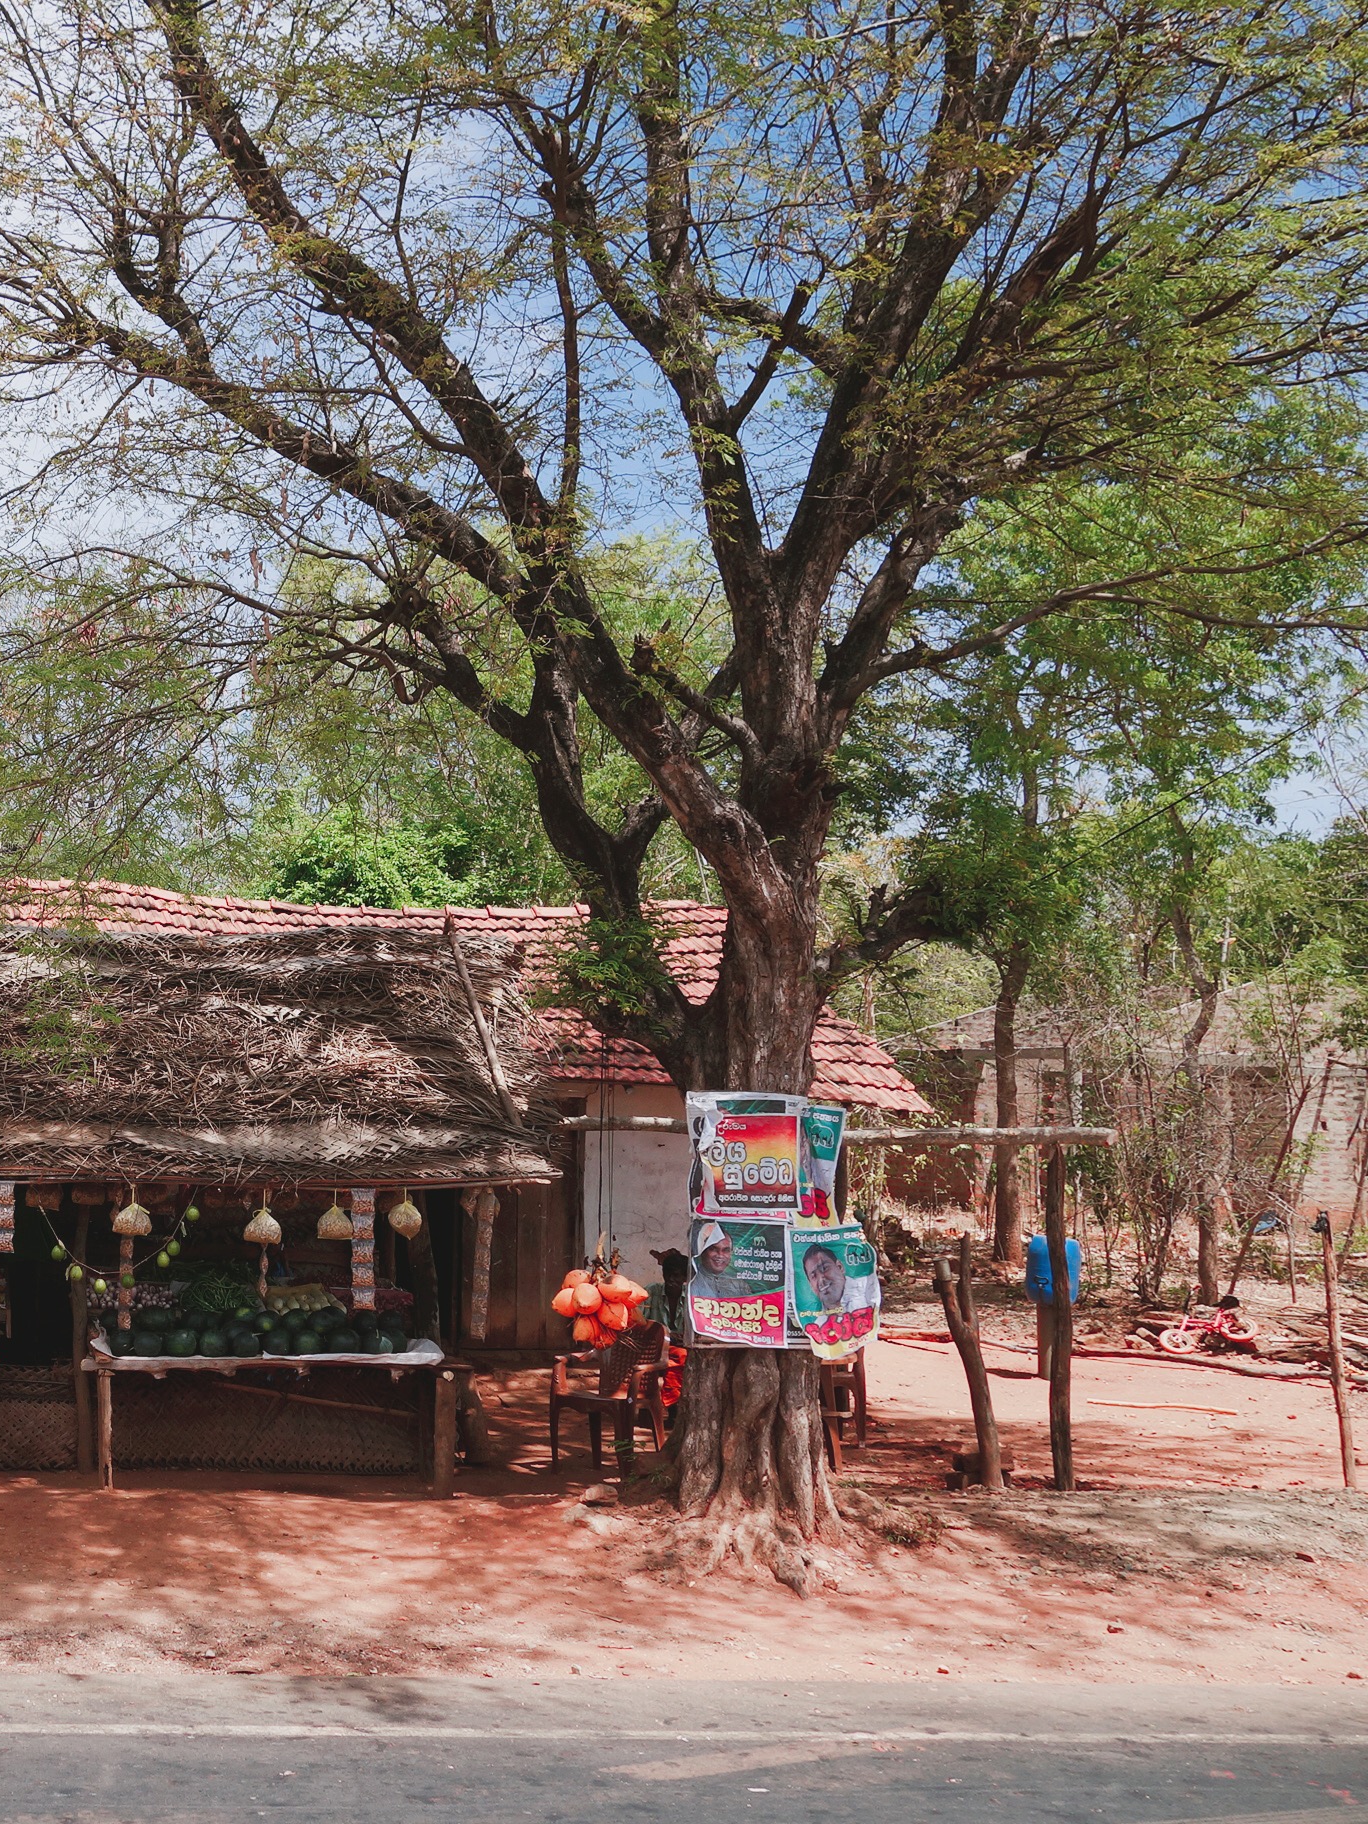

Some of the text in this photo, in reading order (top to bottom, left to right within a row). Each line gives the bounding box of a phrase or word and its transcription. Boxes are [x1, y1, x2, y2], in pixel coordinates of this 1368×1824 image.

[722, 1157, 794, 1191] සුමේධ
[693, 1297, 781, 1328] ආනන්ද
[711, 1317, 762, 1334] කුමාරසිරි
